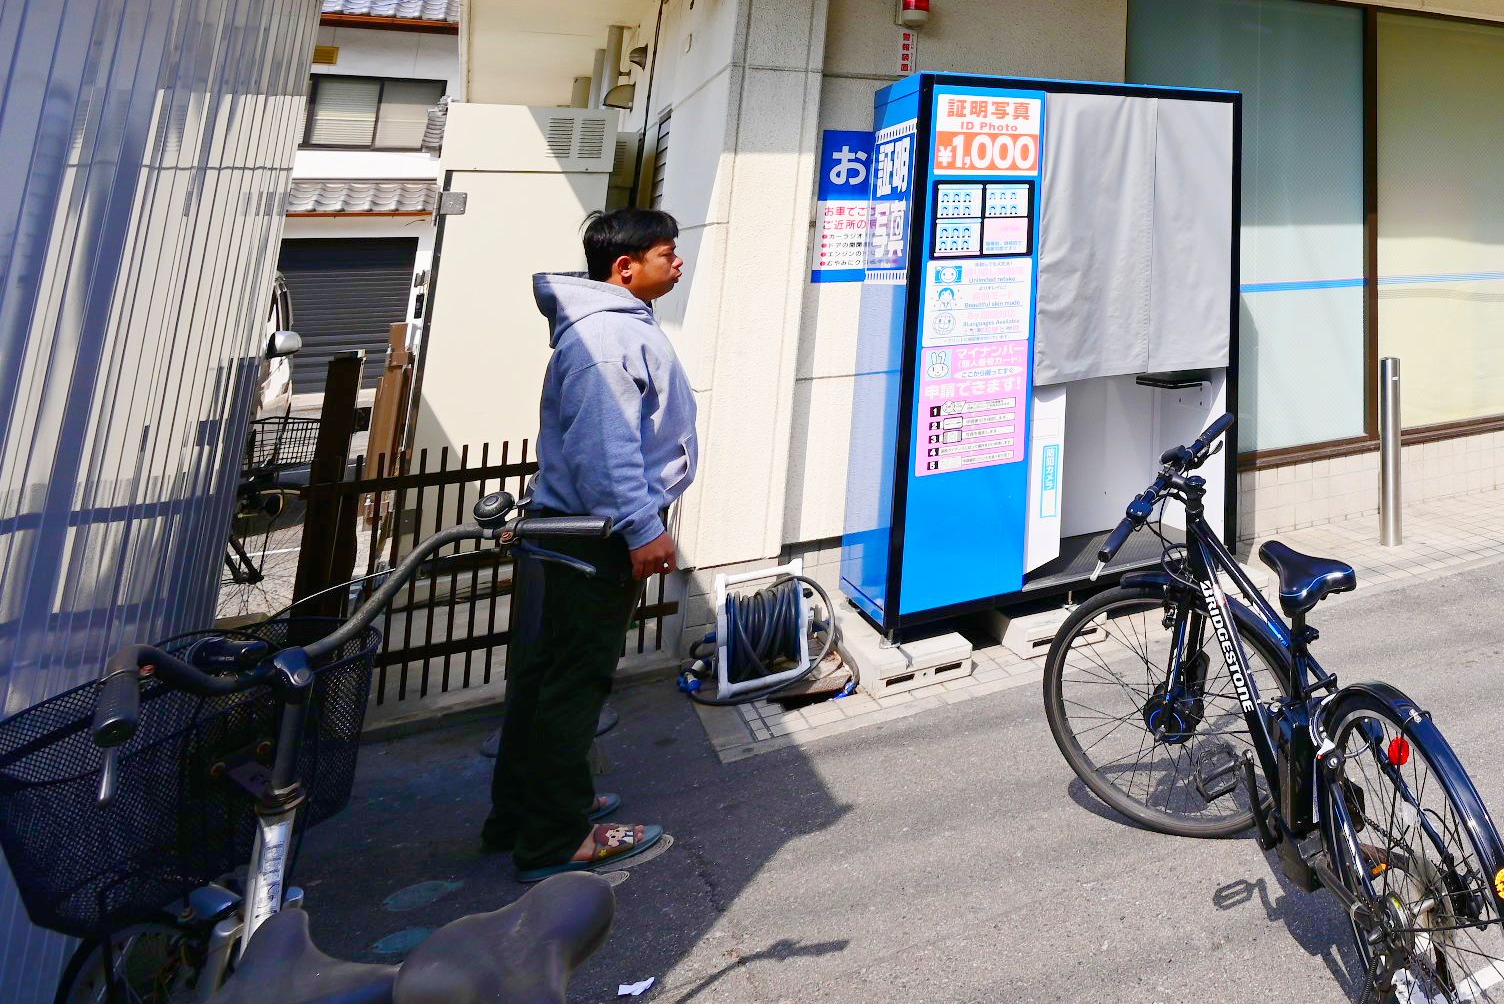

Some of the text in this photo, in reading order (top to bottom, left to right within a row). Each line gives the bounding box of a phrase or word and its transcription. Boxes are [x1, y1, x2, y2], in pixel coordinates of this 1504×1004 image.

[947, 99, 1031, 120] 証明写真
[961, 122, 1018, 131] ID Photo
[938, 134, 1035, 169] ¥1,000
[876, 136, 911, 198] 証明
[956, 344, 1025, 358] マイナンバー
[1200, 580, 1255, 713] BRIDGESTONE
